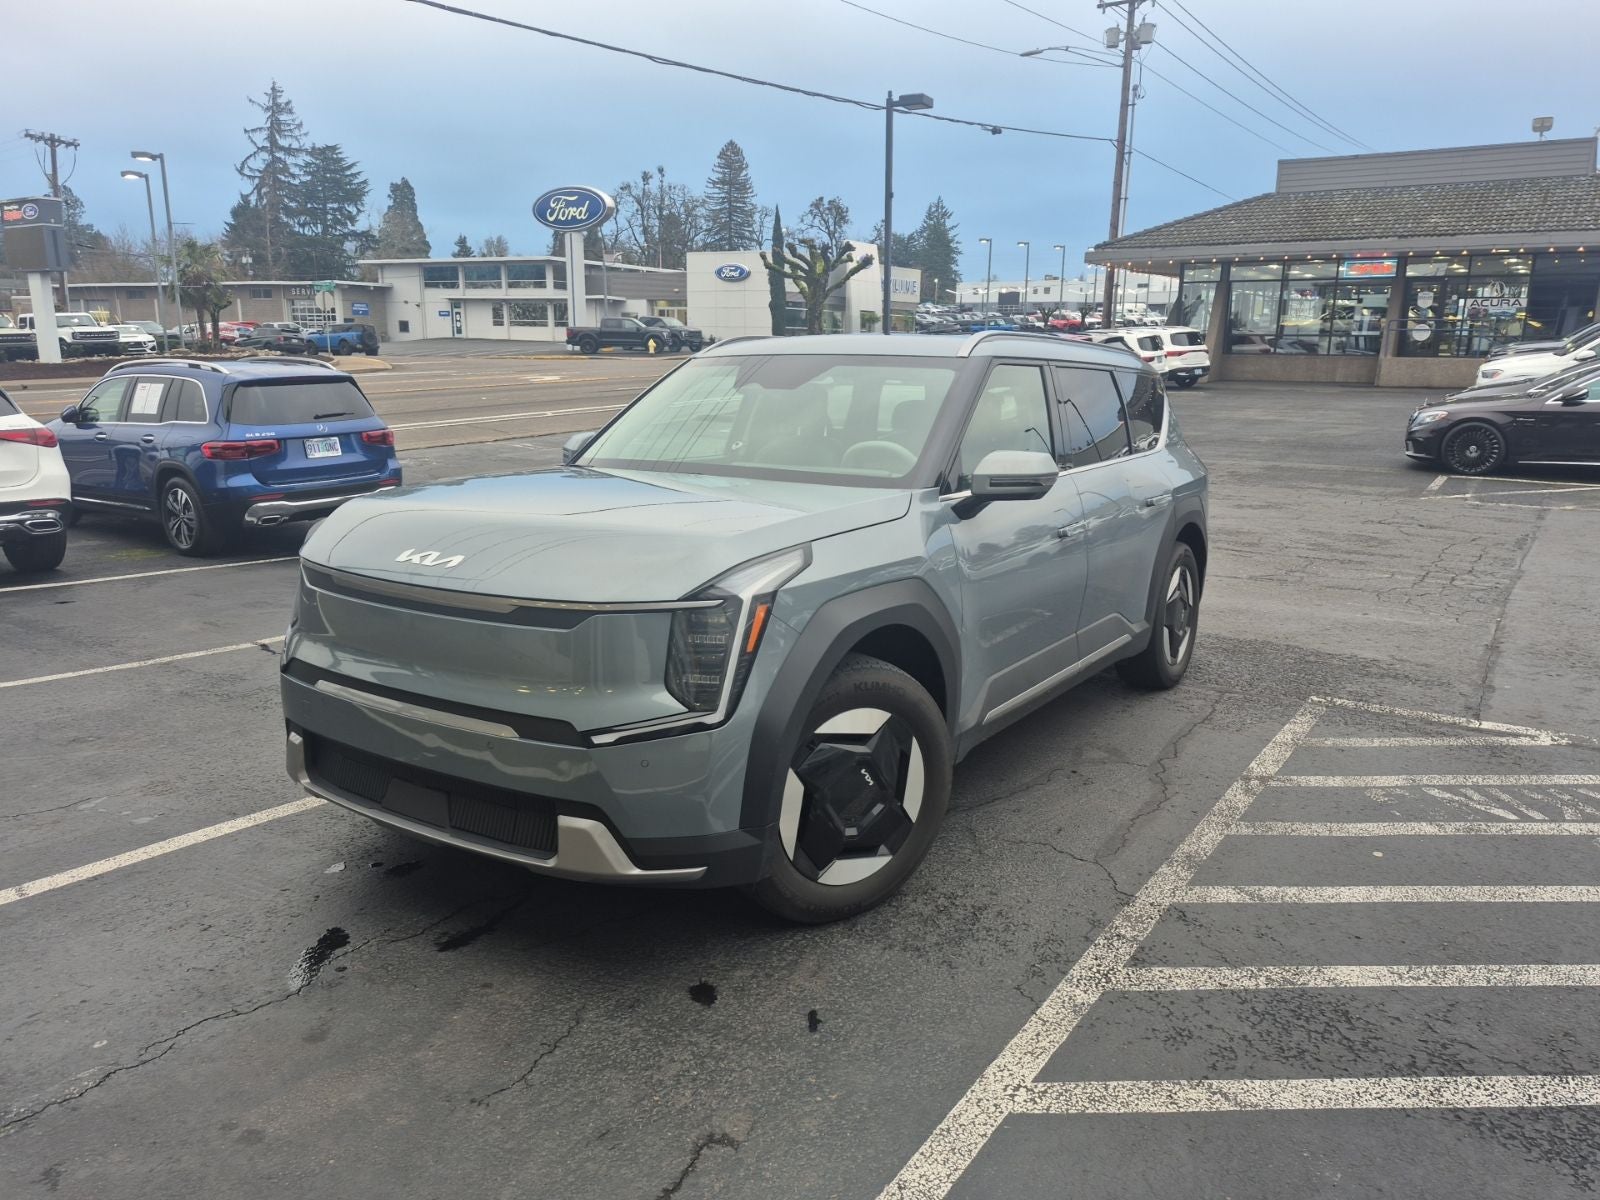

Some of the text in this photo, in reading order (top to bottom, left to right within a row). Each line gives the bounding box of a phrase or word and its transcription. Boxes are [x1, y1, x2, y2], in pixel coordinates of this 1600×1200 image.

[547, 196, 589, 221] Ford
[720, 266, 740, 278] Ford
[1470, 298, 1522, 307] ACURA
